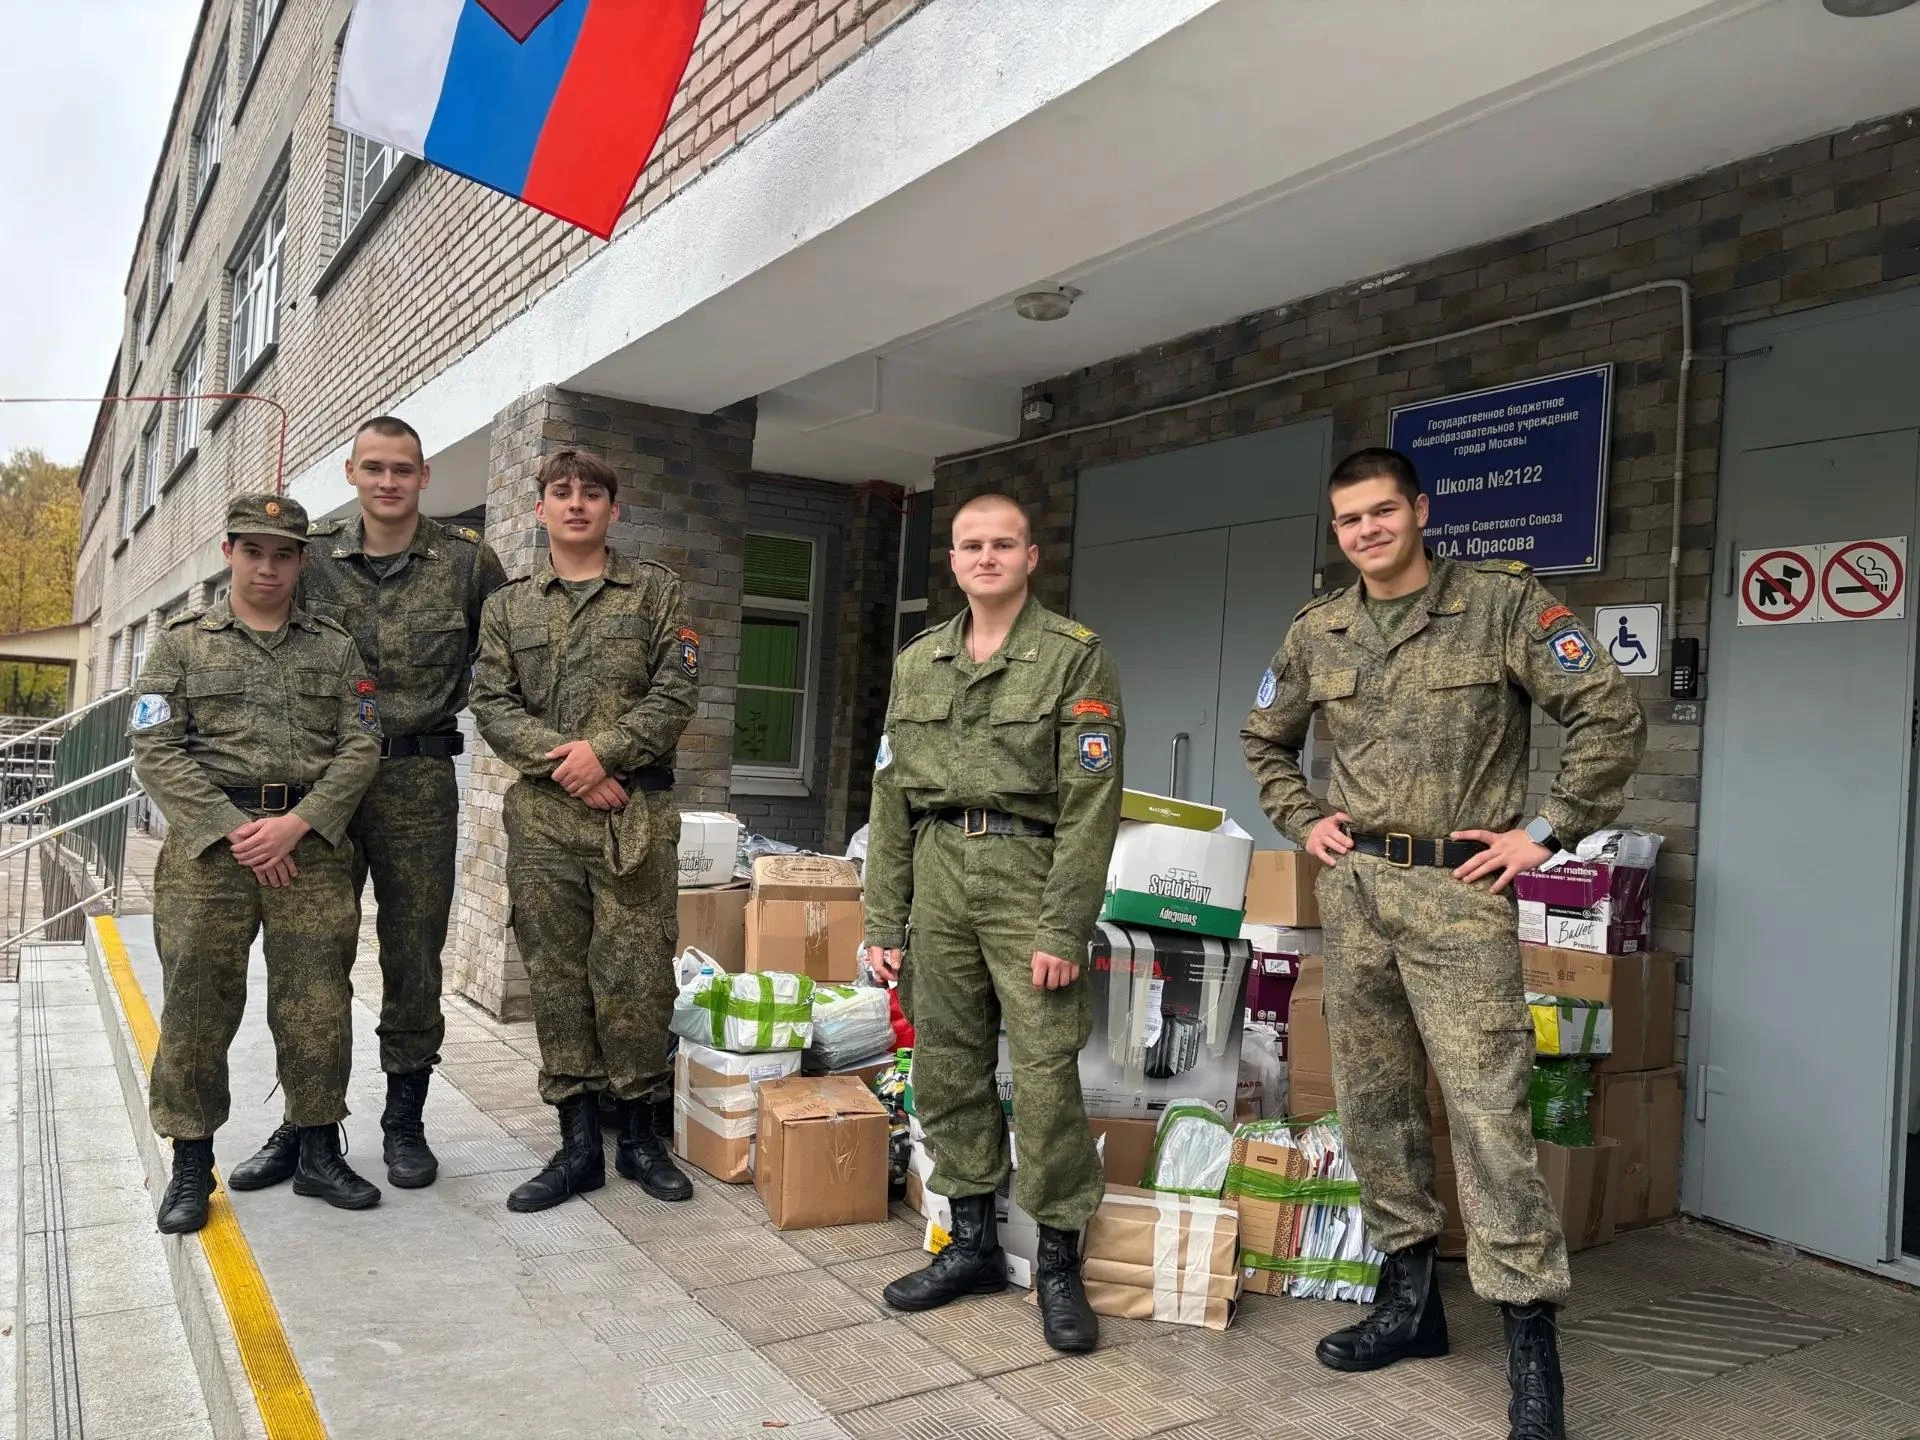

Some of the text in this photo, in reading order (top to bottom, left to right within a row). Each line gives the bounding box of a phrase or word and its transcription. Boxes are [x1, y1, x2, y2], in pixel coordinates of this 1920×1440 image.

[1428, 397, 1565, 431] Государственное бюджетное
[1412, 410, 1579, 448] общеобразовательное учреждение
[1454, 436, 1527, 456] города Москвы
[1436, 464, 1543, 496] Школа №2122
[1422, 513, 1563, 537] мени Героя Советского Союза
[1466, 535, 1535, 558] Юрасова
[1563, 866, 1598, 877] matters
[1149, 874, 1212, 905] SvetoCopy
[1159, 907, 1198, 927] SvetoCopy
[1554, 920, 1597, 945] Ballet
[1573, 941, 1600, 951] Premier
